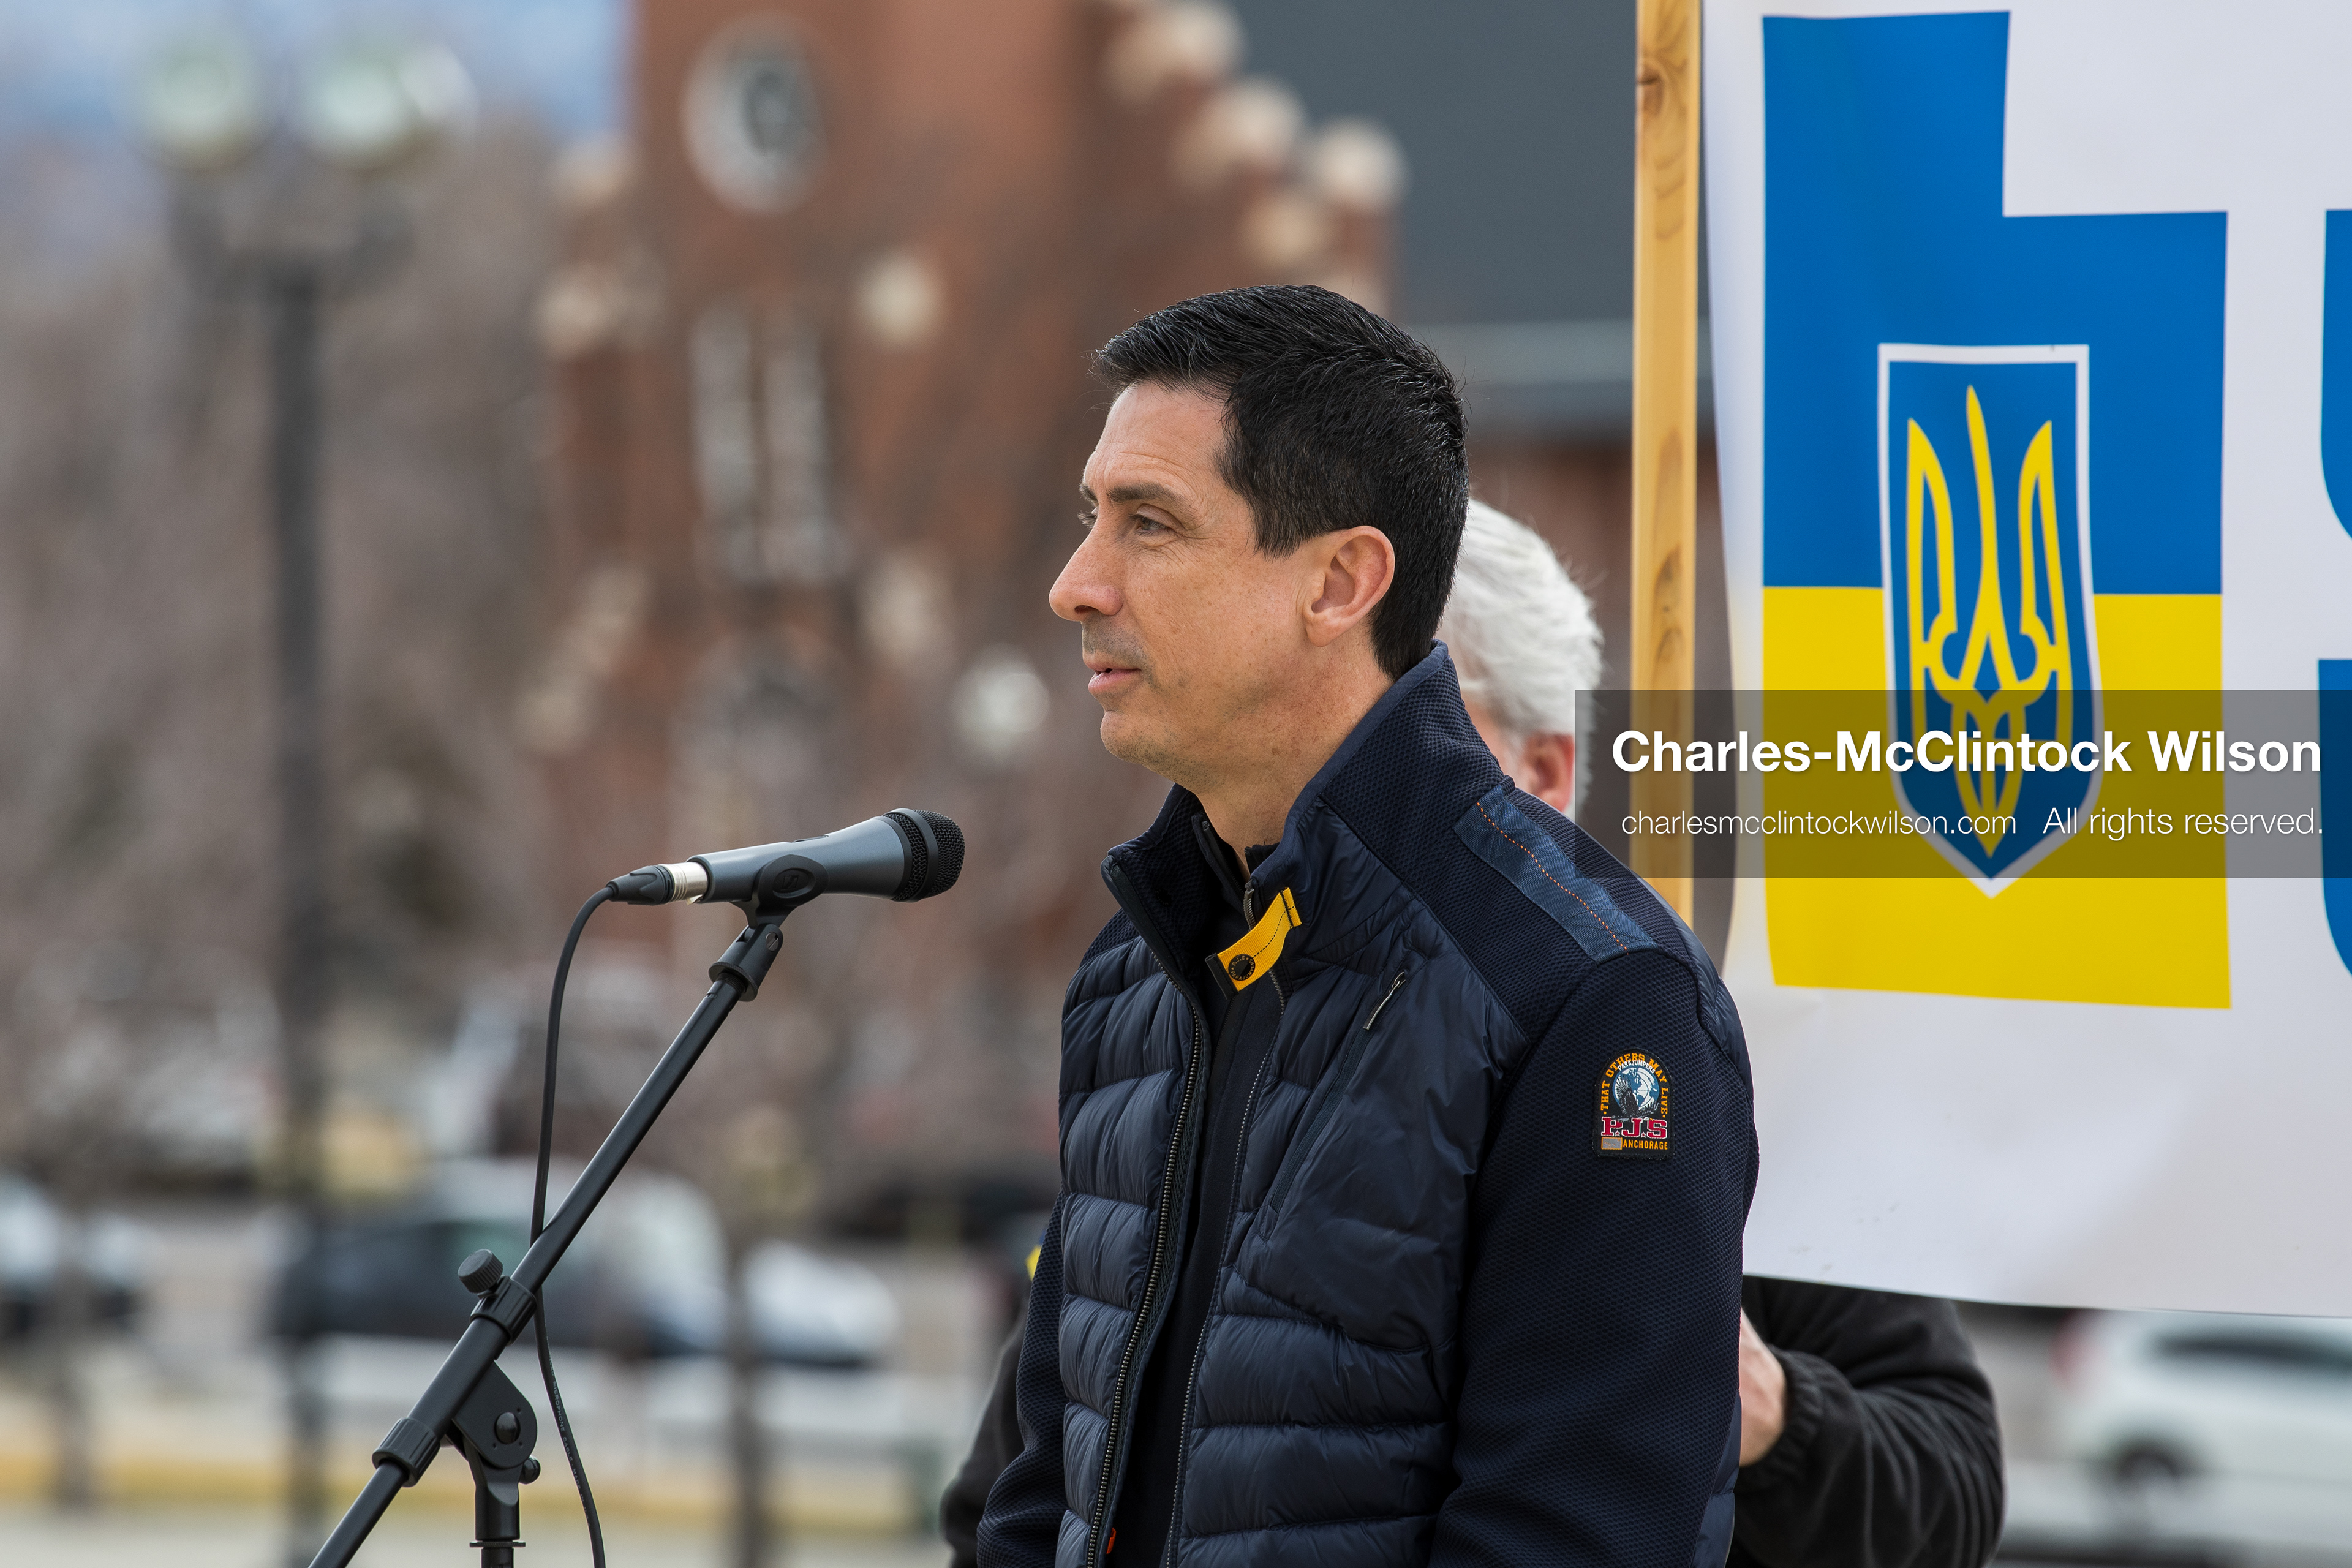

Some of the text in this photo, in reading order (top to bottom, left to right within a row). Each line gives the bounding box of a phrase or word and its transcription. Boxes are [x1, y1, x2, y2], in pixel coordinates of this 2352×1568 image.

[1600, 1080, 1610, 1112] THAT
[1605, 1053, 1645, 1079] OTHERS
[1648, 1059, 1667, 1083] MAY
[1618, 1060, 1656, 1074] PARAJUMPERS
[1623, 1139, 1668, 1150] ANCHORAGE
[552, 1381, 565, 1432] MICROPHONE
[563, 1437, 573, 1461] CABLE
